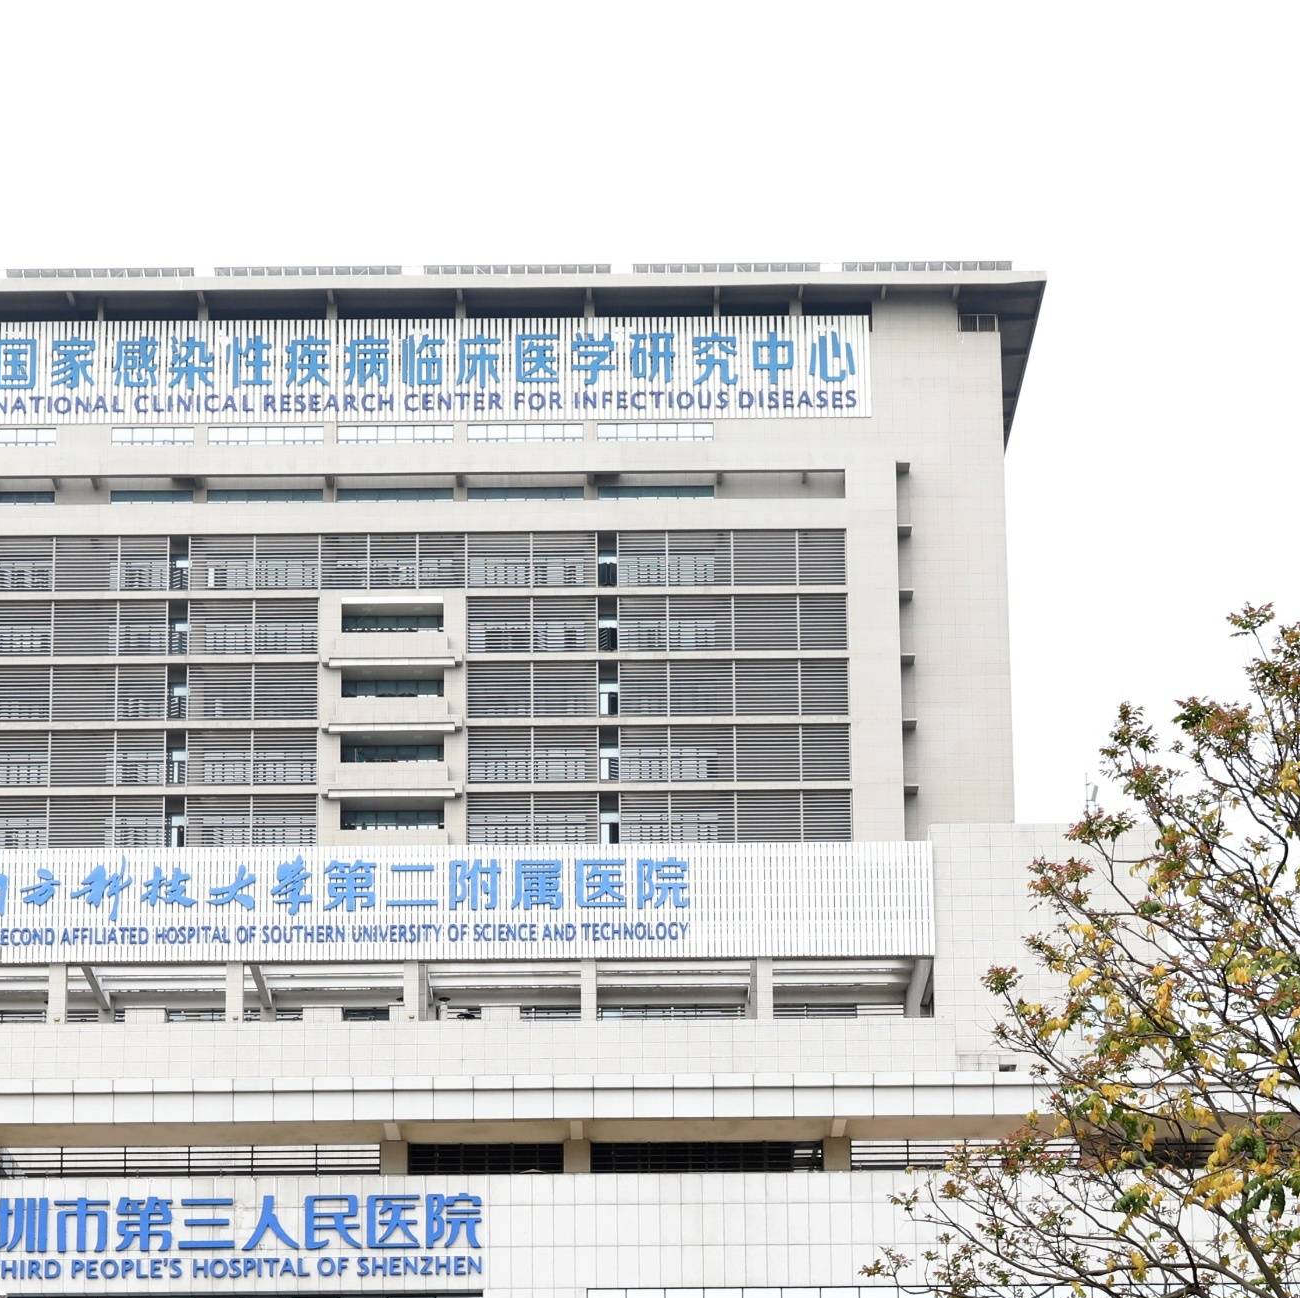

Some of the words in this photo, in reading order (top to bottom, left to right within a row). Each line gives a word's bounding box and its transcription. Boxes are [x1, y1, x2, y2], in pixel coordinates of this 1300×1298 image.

[134, 394, 255, 414] CLINICAL
[263, 394, 395, 414] RESEARCH
[404, 392, 503, 412] CENTER
[514, 392, 563, 411] FOR
[573, 390, 730, 411] INFECTIOUS
[738, 389, 858, 409] DISEASES
[60, 927, 149, 946] AFFILIATED
[155, 926, 231, 945] HOSPITAL
[237, 926, 257, 944] OF
[261, 925, 345, 944] SOUTHERN
[351, 924, 443, 943] UNIVERSITY
[447, 924, 469, 942] OF
[473, 923, 538, 942] SCIENCE
[542, 923, 577, 942] AND
[581, 921, 690, 942] TECHNOLOGY
[71, 1258, 183, 1280] PEOPLE'S
[193, 1257, 310, 1279] HOSPITAL
[317, 1256, 349, 1278] OF
[357, 1255, 484, 1278] SHENZHEN
